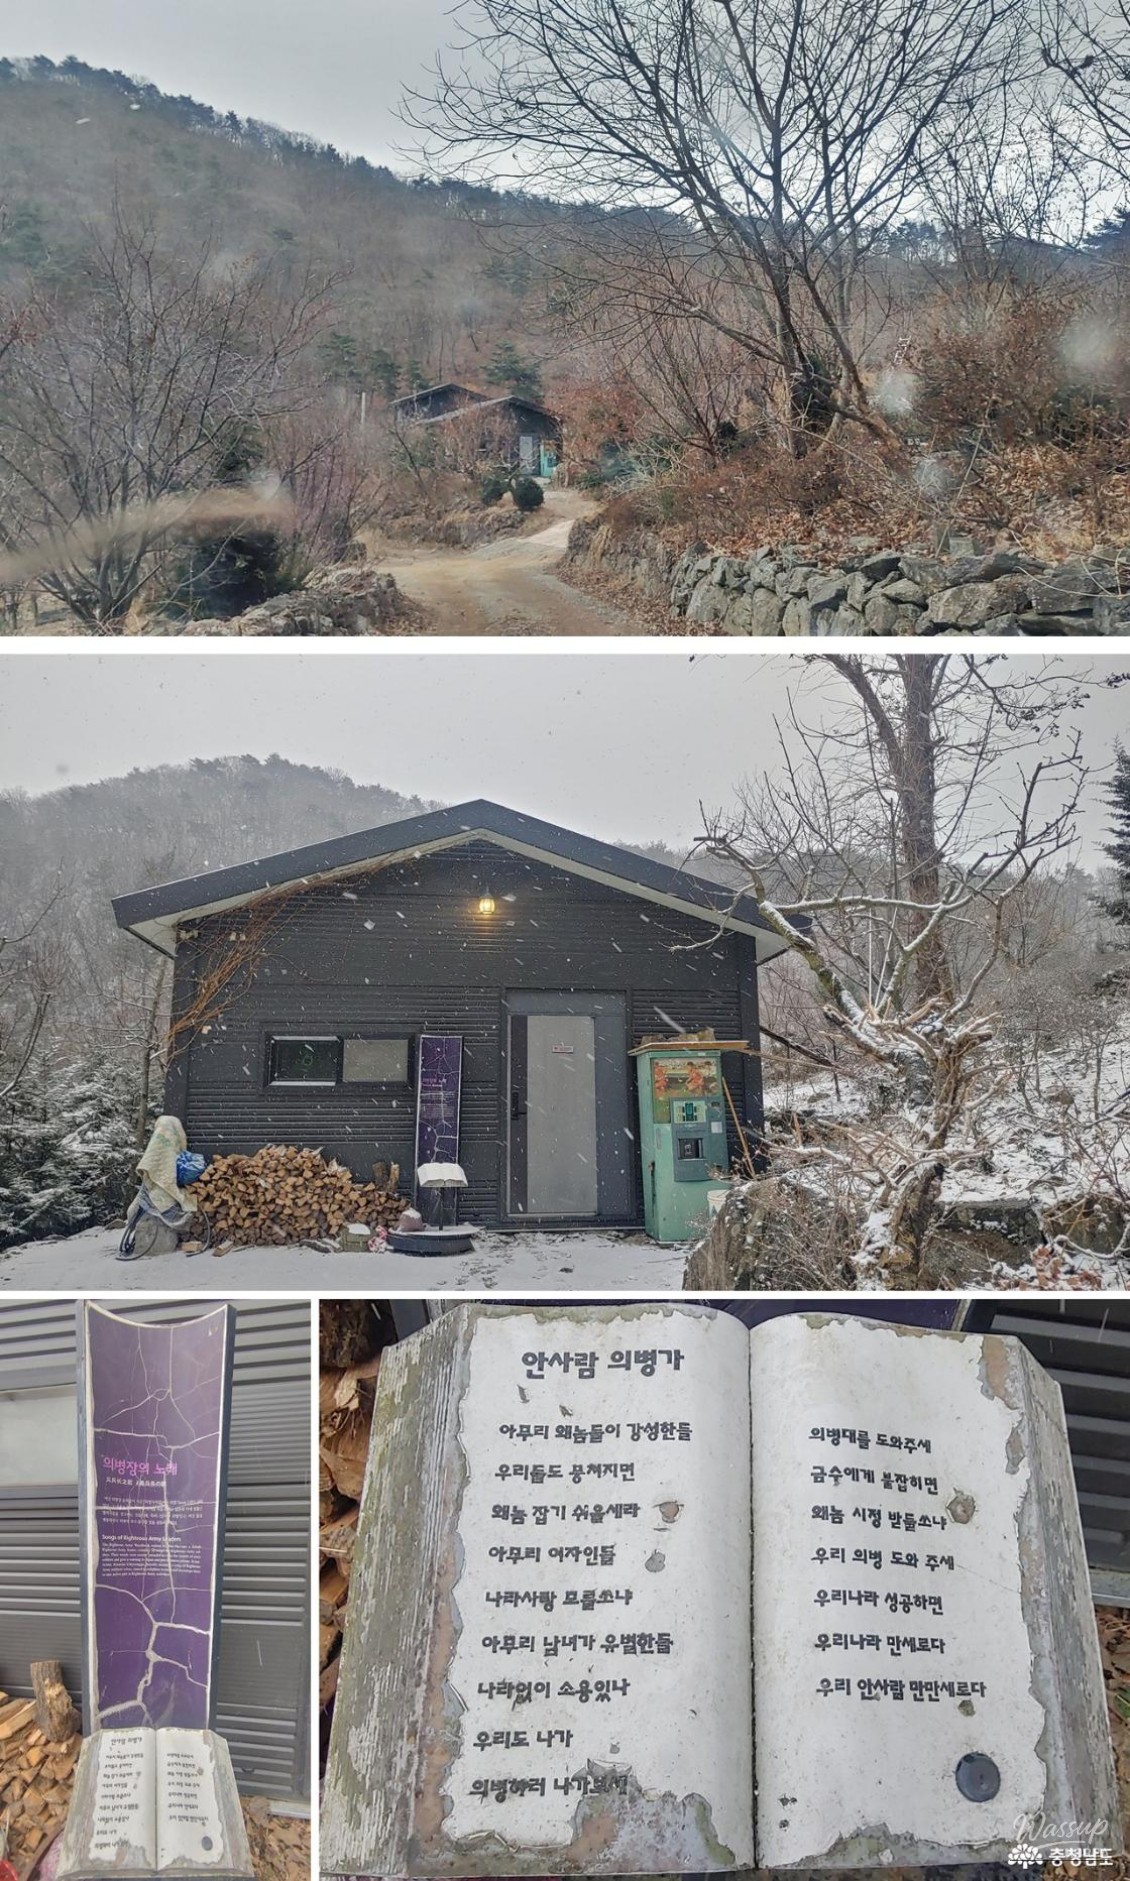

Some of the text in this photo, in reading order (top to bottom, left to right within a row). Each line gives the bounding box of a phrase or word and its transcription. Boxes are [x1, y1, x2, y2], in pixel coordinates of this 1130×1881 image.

[521, 1349, 684, 1379] 안사람 의병가
[499, 1422, 692, 1443] 아무리 왜놈들이 강성한들
[808, 1427, 931, 1454] 의병대를 도와주세
[104, 1458, 178, 1476] 의병장의 노래
[494, 1464, 563, 1484] 우리들도
[811, 1466, 875, 1485] 금수에게
[491, 1503, 640, 1525] 왜놈 잡기 쉬울세라
[811, 1505, 845, 1524] 왜놈
[852, 1506, 882, 1528] 시정
[488, 1545, 616, 1566] 아무리 여자인들
[811, 1548, 954, 1571] 우리 의병 도와 주세
[485, 1590, 557, 1612] 나라사랑
[814, 1589, 943, 1615] 우리나라 성공하면
[482, 1632, 673, 1656] 아무리 남녀가 유별한들
[815, 1633, 946, 1656] 우리나라 만세로다
[478, 1678, 630, 1703] 나라없이 소용있나
[816, 1678, 986, 1701] 우리 안사람 만만세로다
[473, 1730, 573, 1751] 우리도 나가
[469, 1778, 545, 1803] 의병하러
